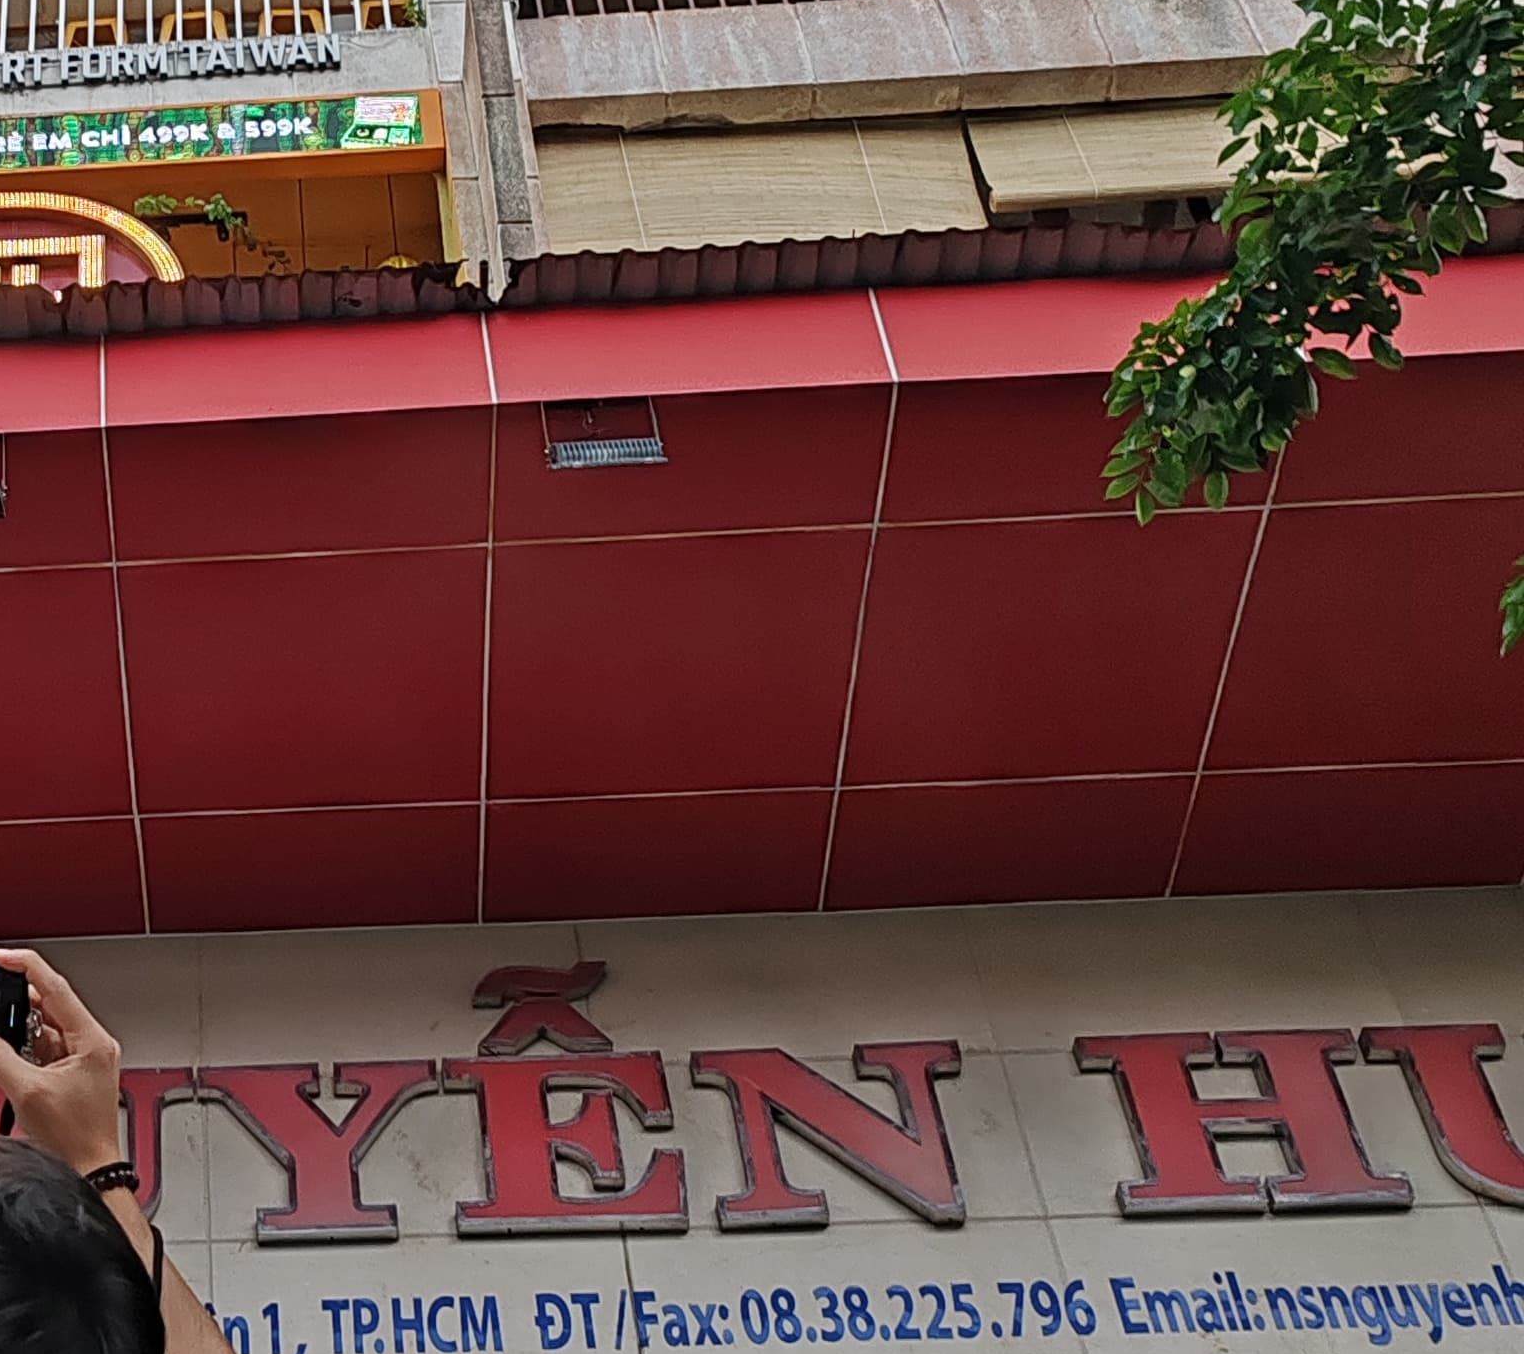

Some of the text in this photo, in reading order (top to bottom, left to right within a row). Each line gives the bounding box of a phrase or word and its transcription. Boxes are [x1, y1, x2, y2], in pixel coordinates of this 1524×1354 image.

[59, 44, 169, 86] FORM
[179, 31, 342, 77] TAIWAN
[32, 131, 73, 151] EM
[137, 121, 210, 146] 499K
[244, 116, 315, 141] 599K
